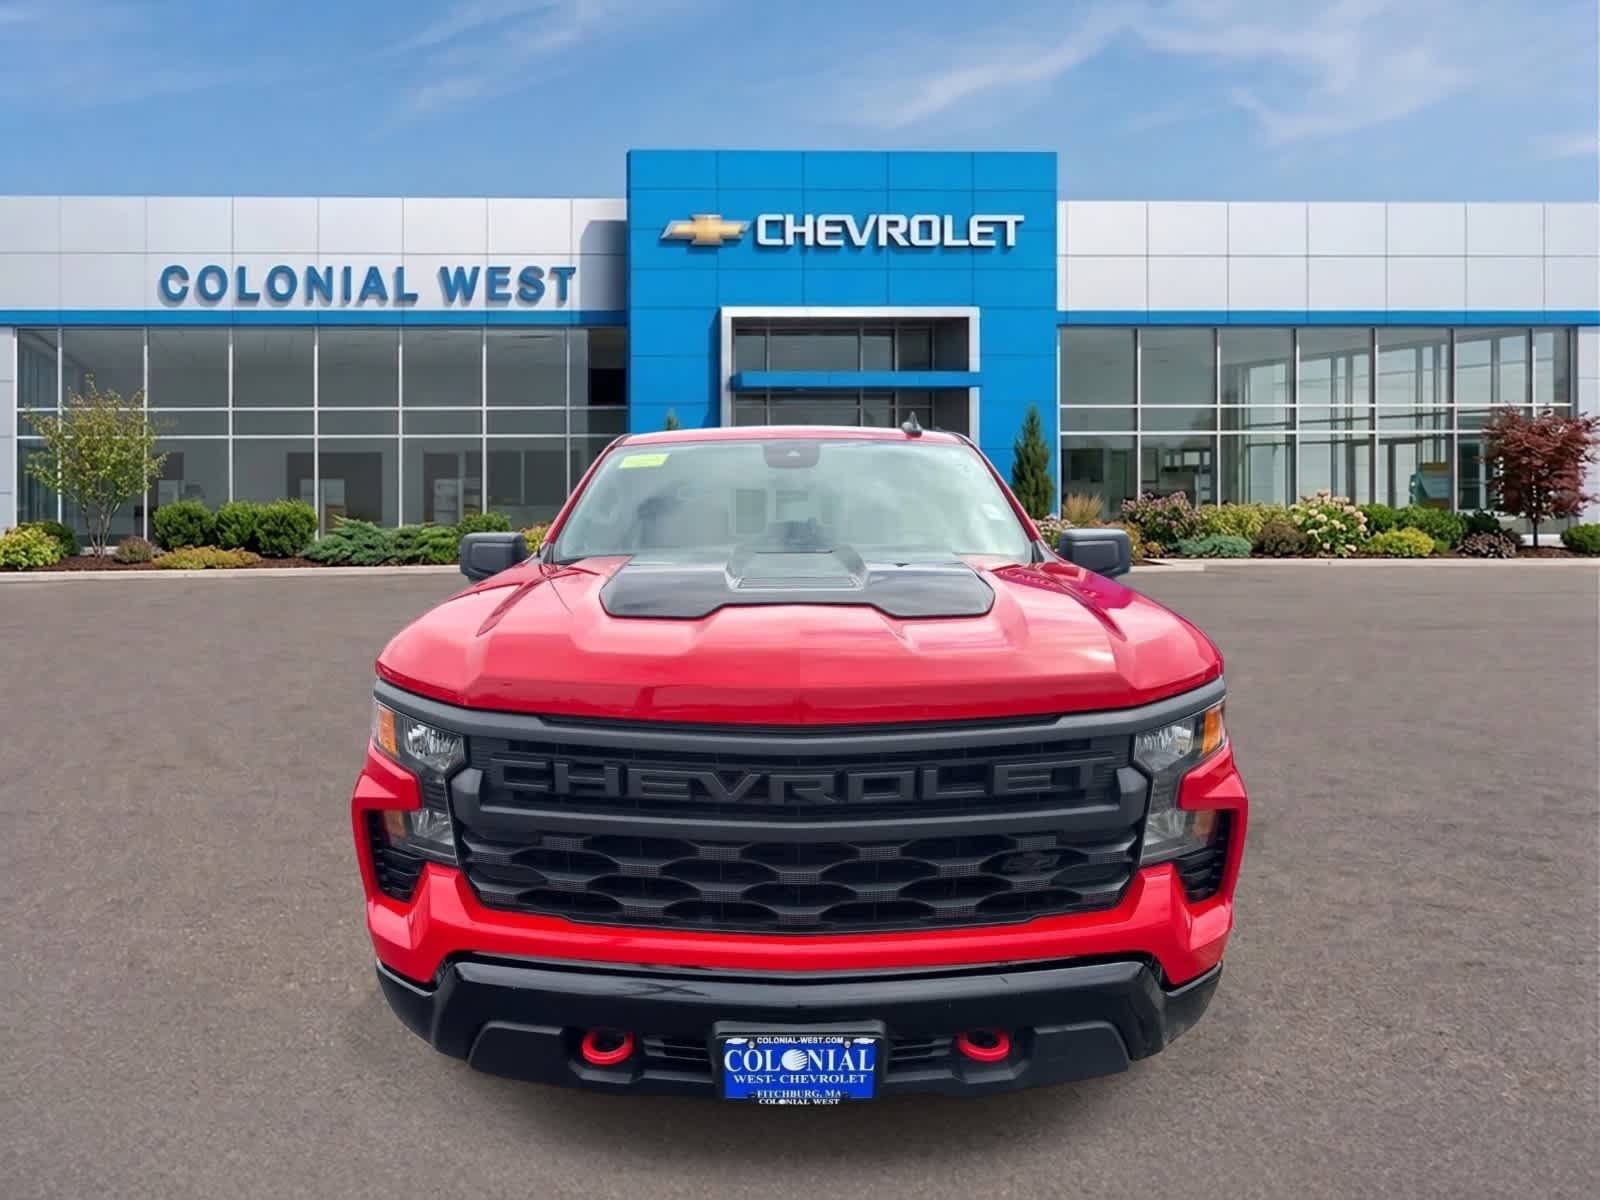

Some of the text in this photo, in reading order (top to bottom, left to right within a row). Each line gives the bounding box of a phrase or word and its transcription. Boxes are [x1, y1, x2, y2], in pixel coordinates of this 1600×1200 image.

[757, 214, 1025, 246] CHEVROLET
[159, 264, 577, 306] COLONIAL WEST
[489, 752, 1117, 804] CHEVROLET
[756, 1036, 844, 1045] COLONIAL-WEST.COM
[724, 1049, 875, 1072] COLONIAL
[779, 1074, 867, 1084] CHEVROLET
[824, 1089, 842, 1099] MA
